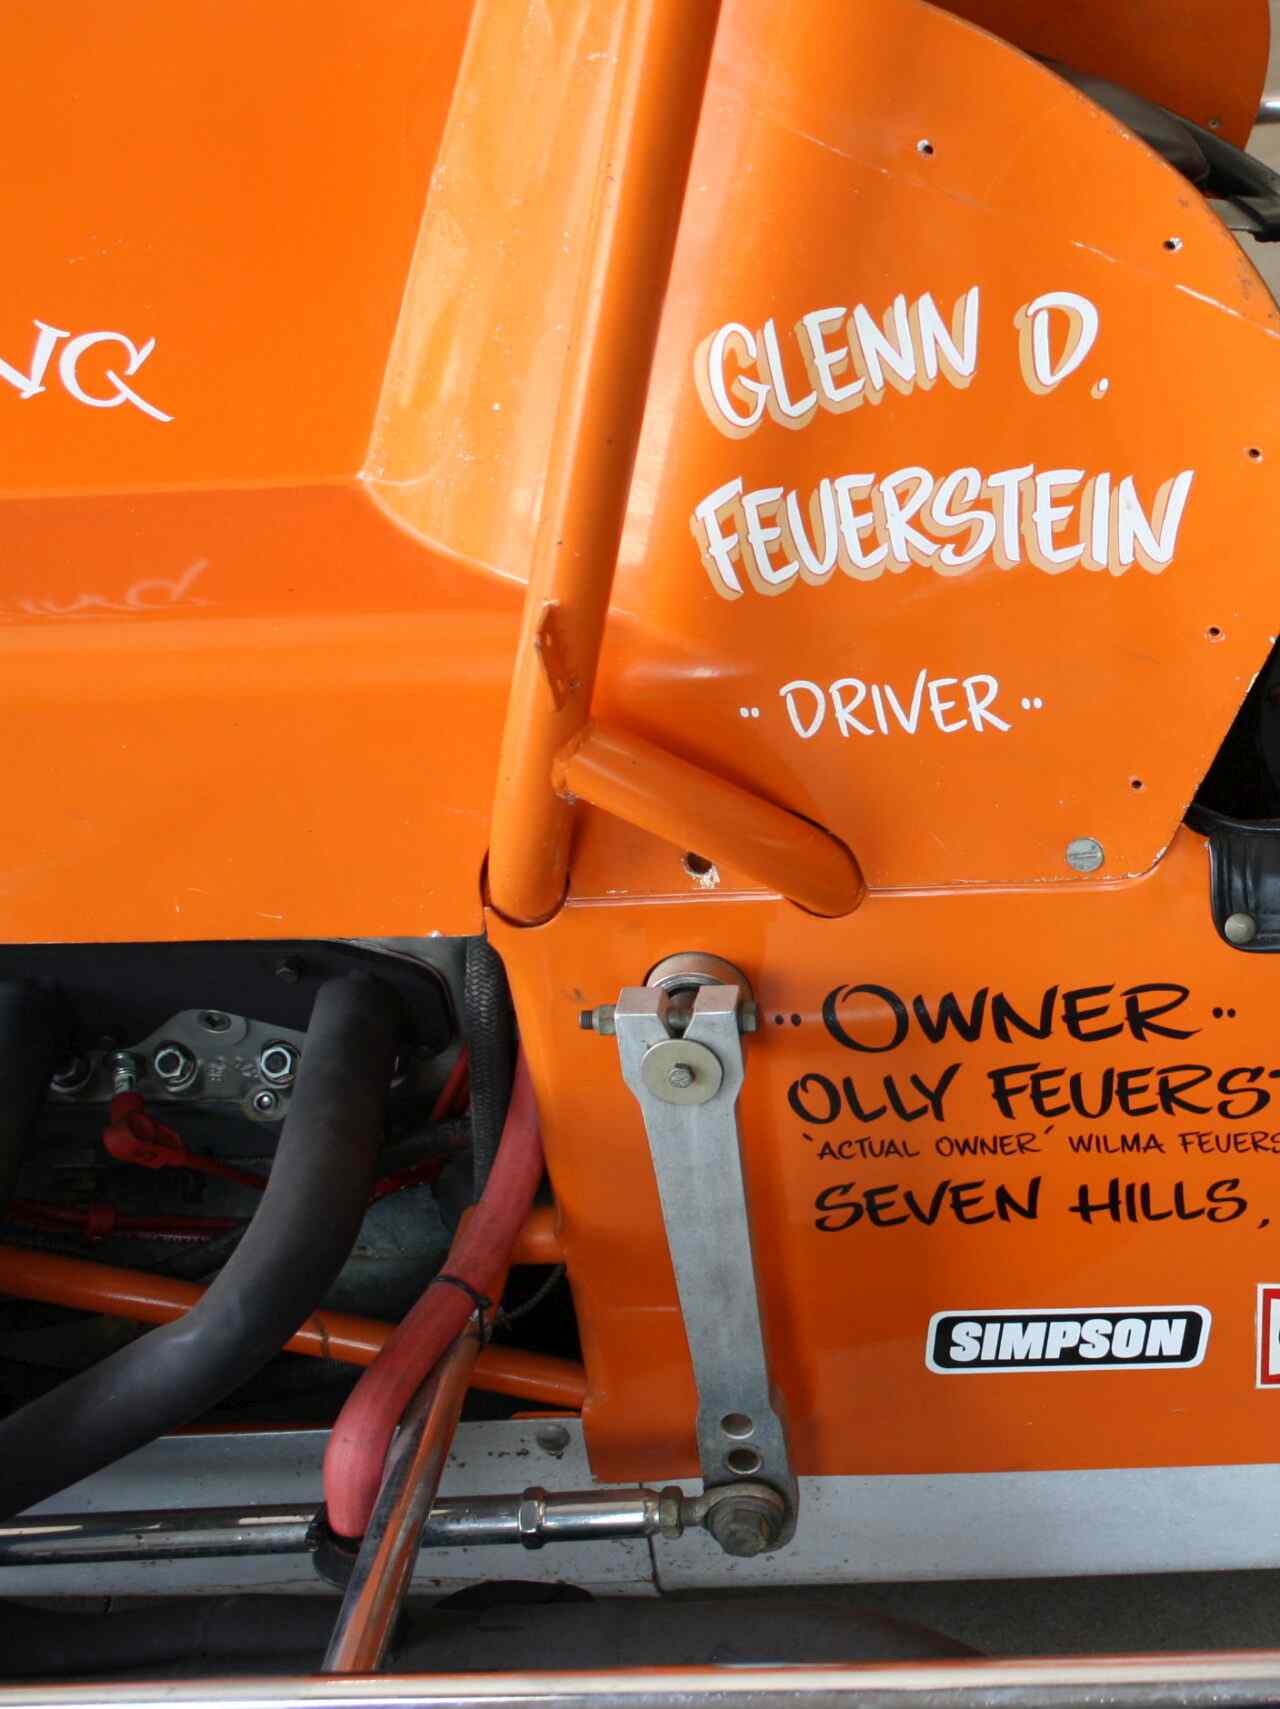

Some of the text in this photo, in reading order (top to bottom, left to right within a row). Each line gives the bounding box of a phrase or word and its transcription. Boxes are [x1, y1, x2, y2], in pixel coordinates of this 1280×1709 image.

[693, 285, 980, 440] GLENN
[690, 463, 1195, 601] FEUERSTEIN
[786, 1062, 964, 1126] OLLY
[1067, 1132, 1167, 1156] WILMA
[813, 1175, 1043, 1233] SEVEN
[948, 1318, 1189, 1363] SIMPSON
